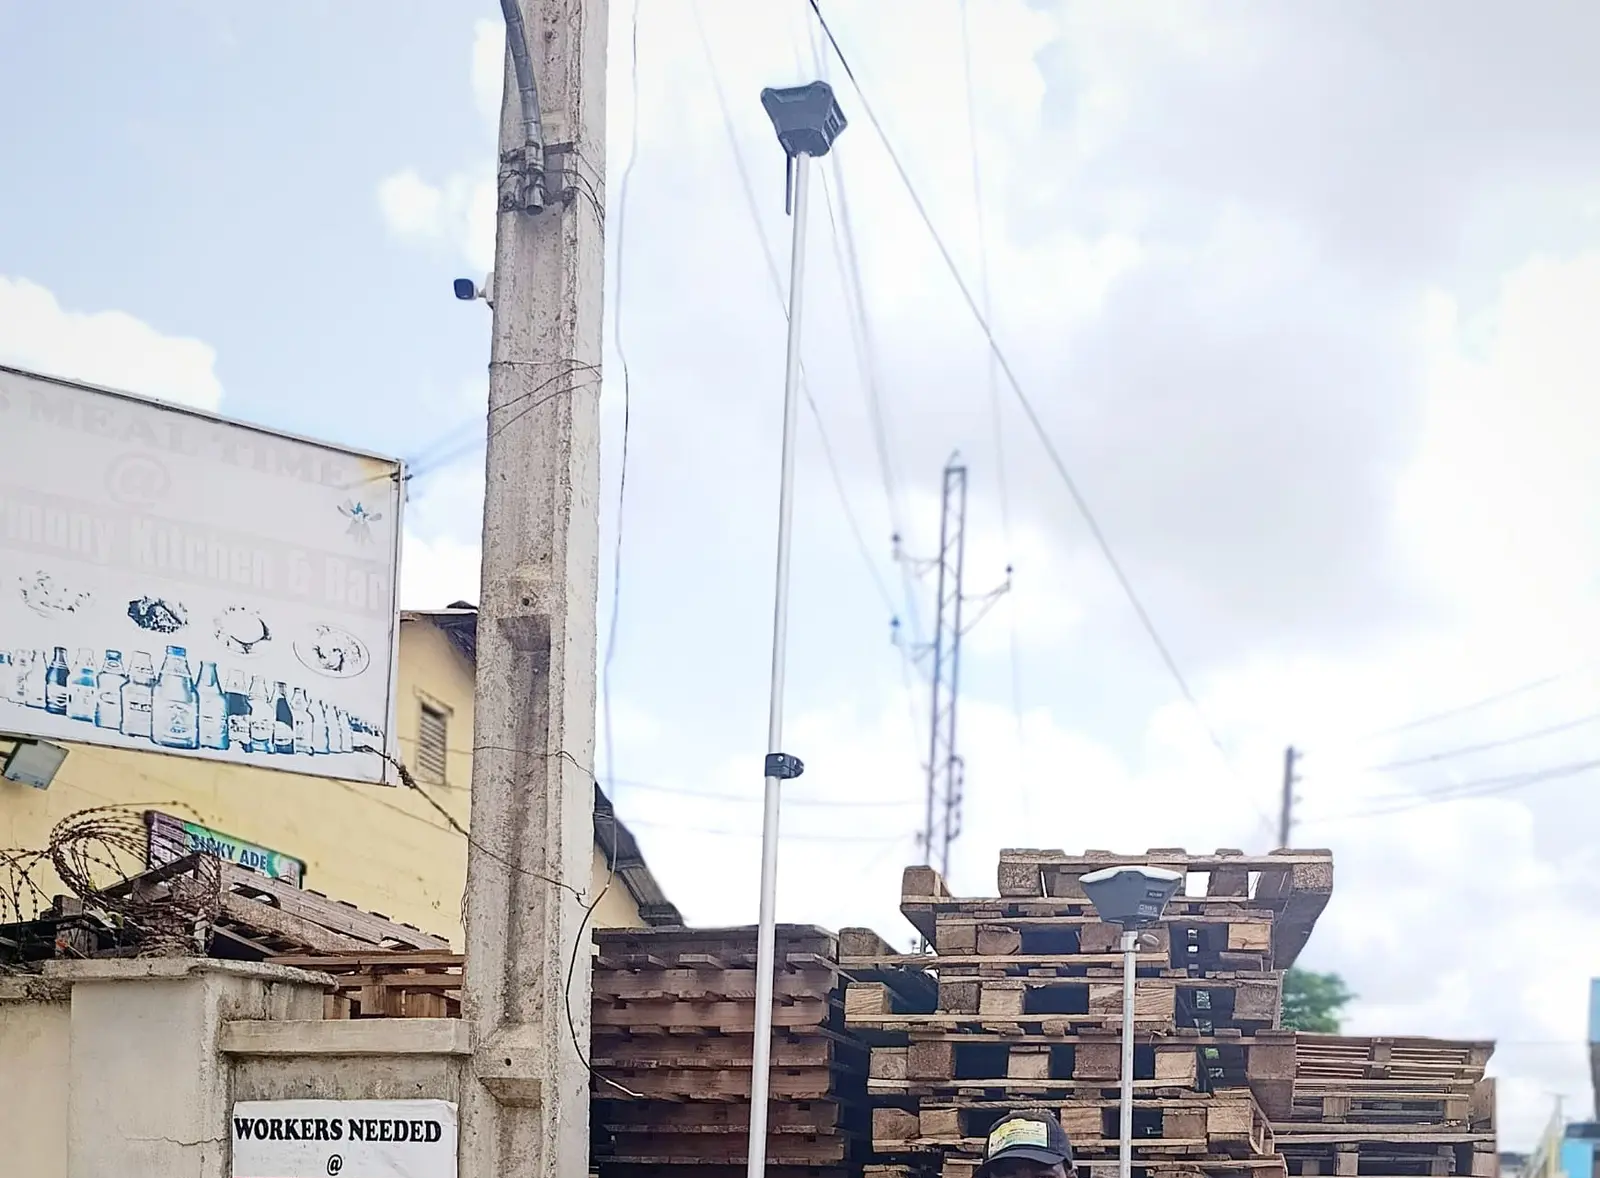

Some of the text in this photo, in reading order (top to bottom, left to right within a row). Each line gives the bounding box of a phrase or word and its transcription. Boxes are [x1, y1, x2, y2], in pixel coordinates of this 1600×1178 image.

[28, 391, 199, 456] MEAL
[212, 430, 350, 488] TIME
[325, 557, 388, 611] Bar
[239, 849, 267, 870] ADE
[234, 1117, 442, 1142] WORKERS NEEDED
[326, 1154, 343, 1176] @
